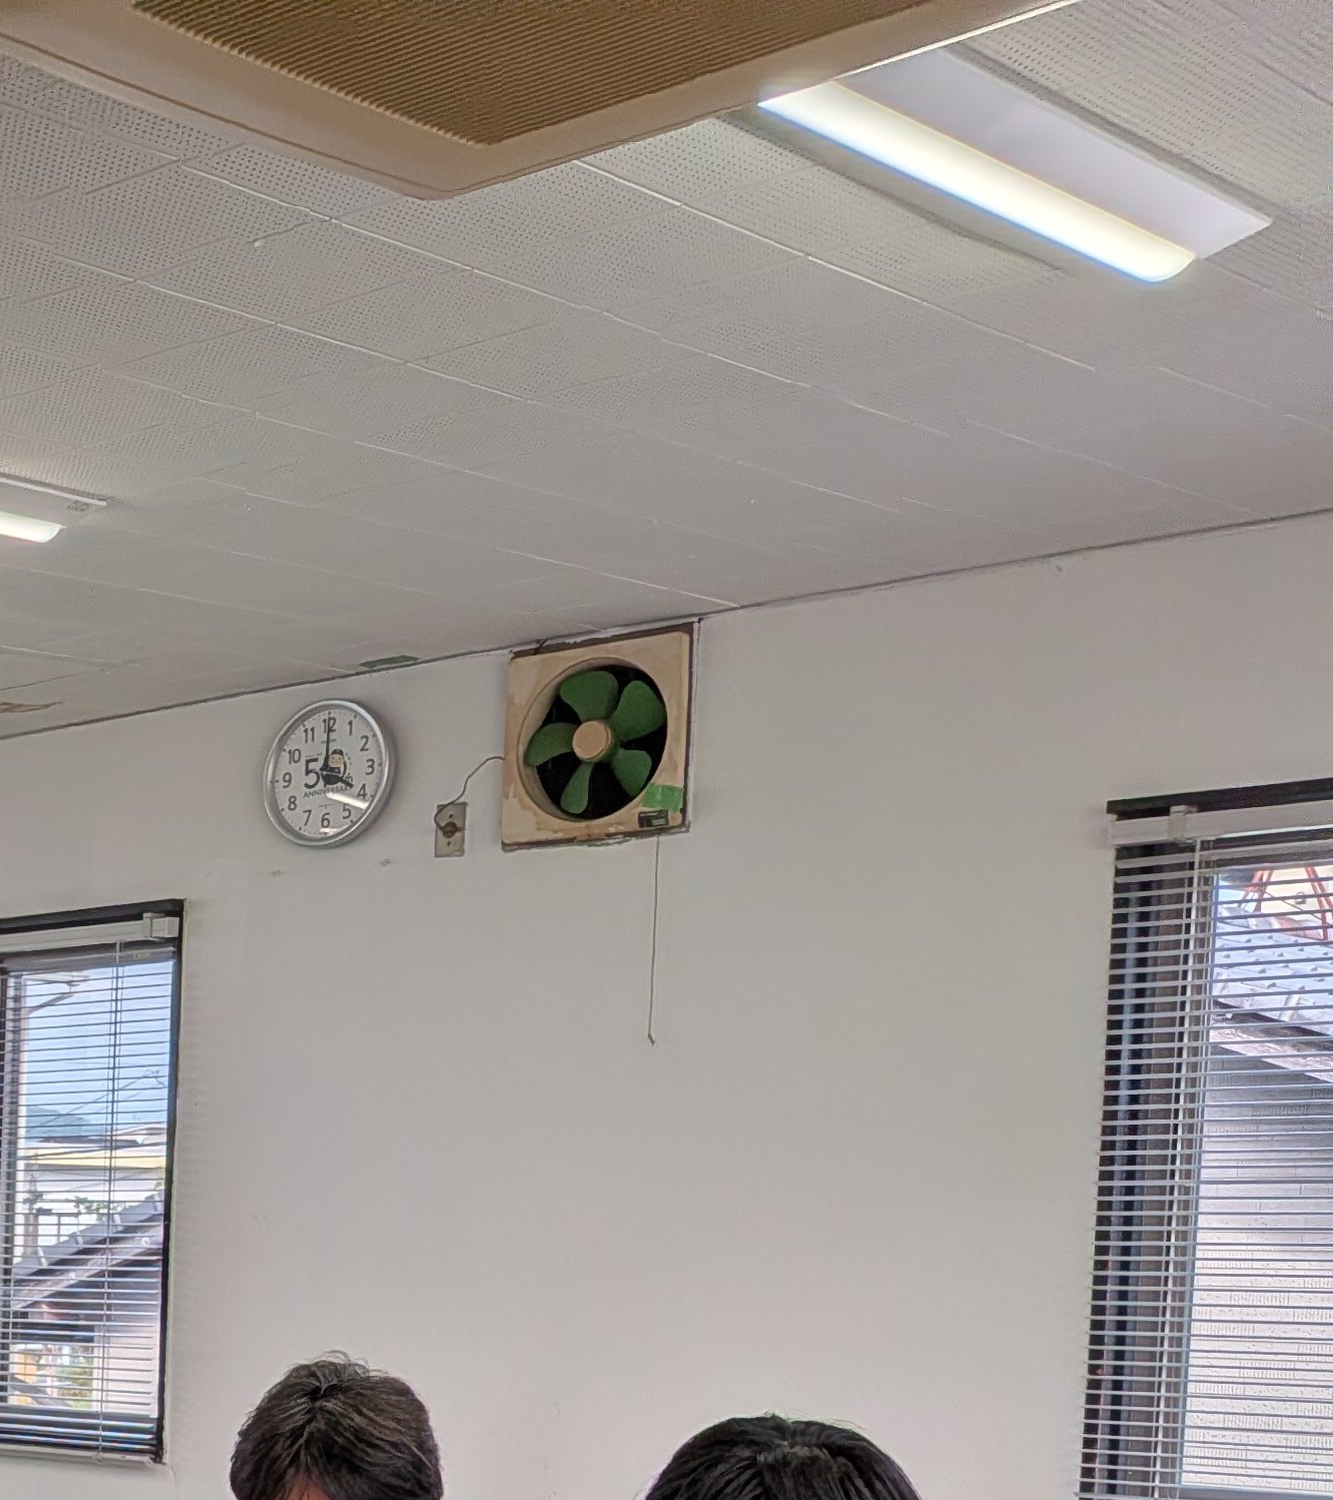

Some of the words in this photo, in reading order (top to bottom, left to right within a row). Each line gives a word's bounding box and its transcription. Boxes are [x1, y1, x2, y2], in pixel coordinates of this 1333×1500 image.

[322, 717, 337, 732] 12
[348, 720, 353, 736] 1
[303, 727, 315, 743] 11
[360, 735, 370, 751] 2
[287, 748, 301, 764] 10
[365, 758, 375, 775] 3
[282, 772, 292, 789] 9
[357, 783, 367, 799] 4
[288, 795, 297, 811] 8
[342, 803, 352, 819] 5
[303, 810, 312, 826] 7
[321, 813, 331, 828] 6
